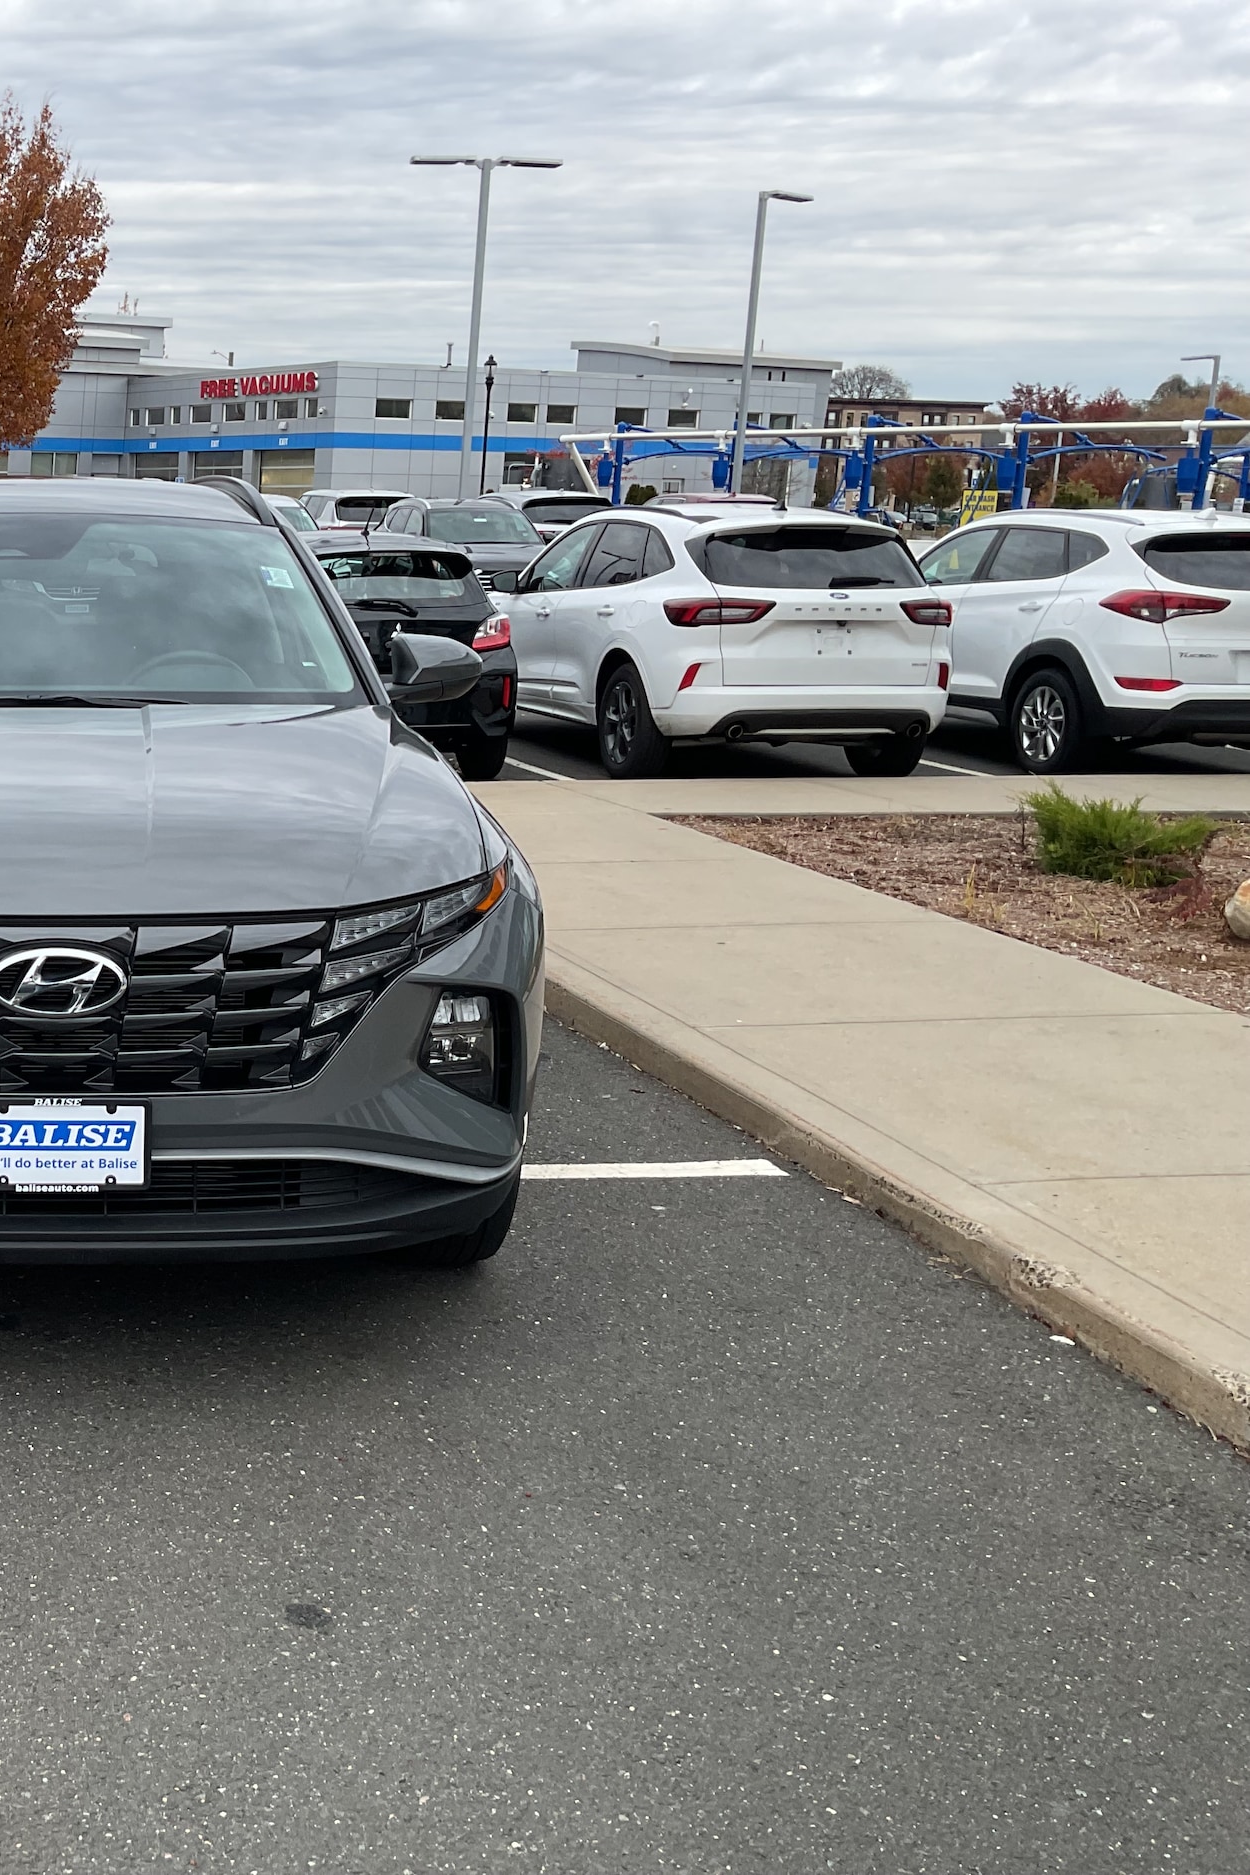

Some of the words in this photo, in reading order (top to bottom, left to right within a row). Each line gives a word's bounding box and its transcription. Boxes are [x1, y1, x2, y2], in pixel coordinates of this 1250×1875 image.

[200, 379, 236, 398] FREE
[240, 371, 318, 395] VACUUMS
[963, 504, 994, 512] NTANCE
[34, 1098, 83, 1107] BALISE
[15, 1157, 31, 1169] do
[36, 1157, 77, 1169] better
[81, 1158, 95, 1169] at
[100, 1157, 138, 1169] Balise
[15, 1183, 100, 1193] baliseauto.com
